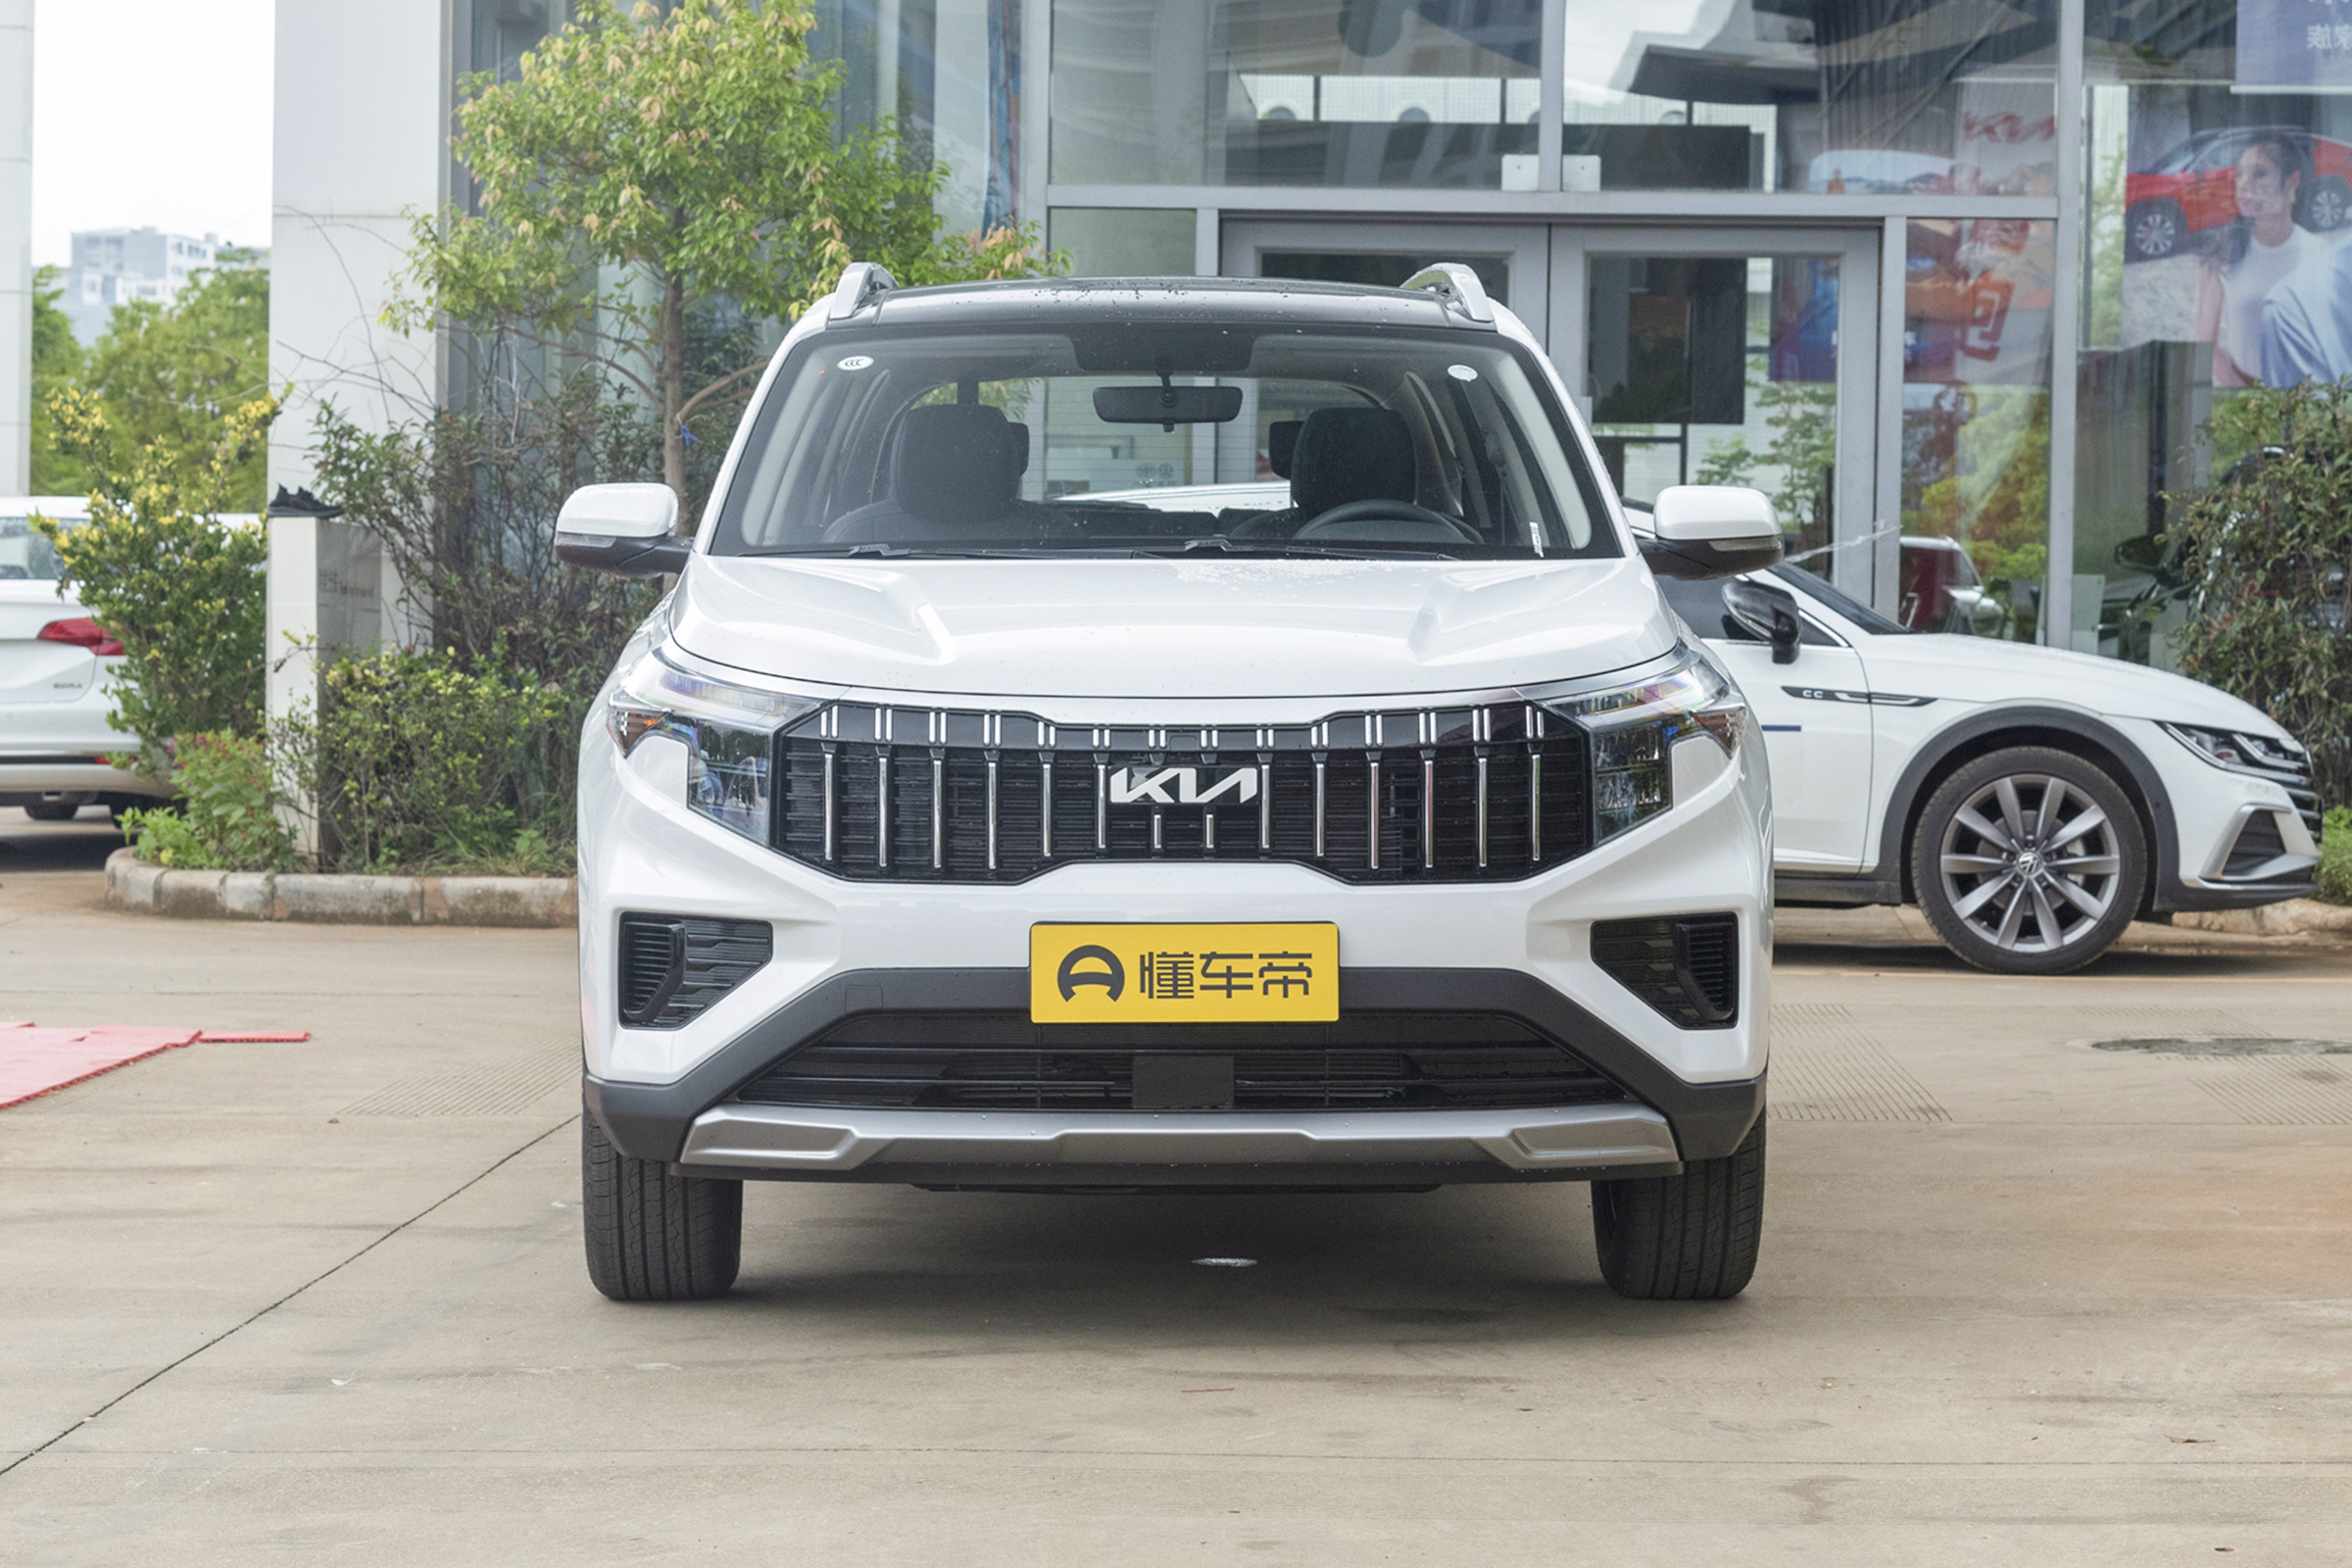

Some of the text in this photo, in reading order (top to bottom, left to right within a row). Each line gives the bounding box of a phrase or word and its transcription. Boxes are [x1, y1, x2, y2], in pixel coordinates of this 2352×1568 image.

[1801, 689, 1824, 700] CC
[1109, 766, 1258, 805] KIA
[1139, 951, 1313, 1000] 懂车帝
